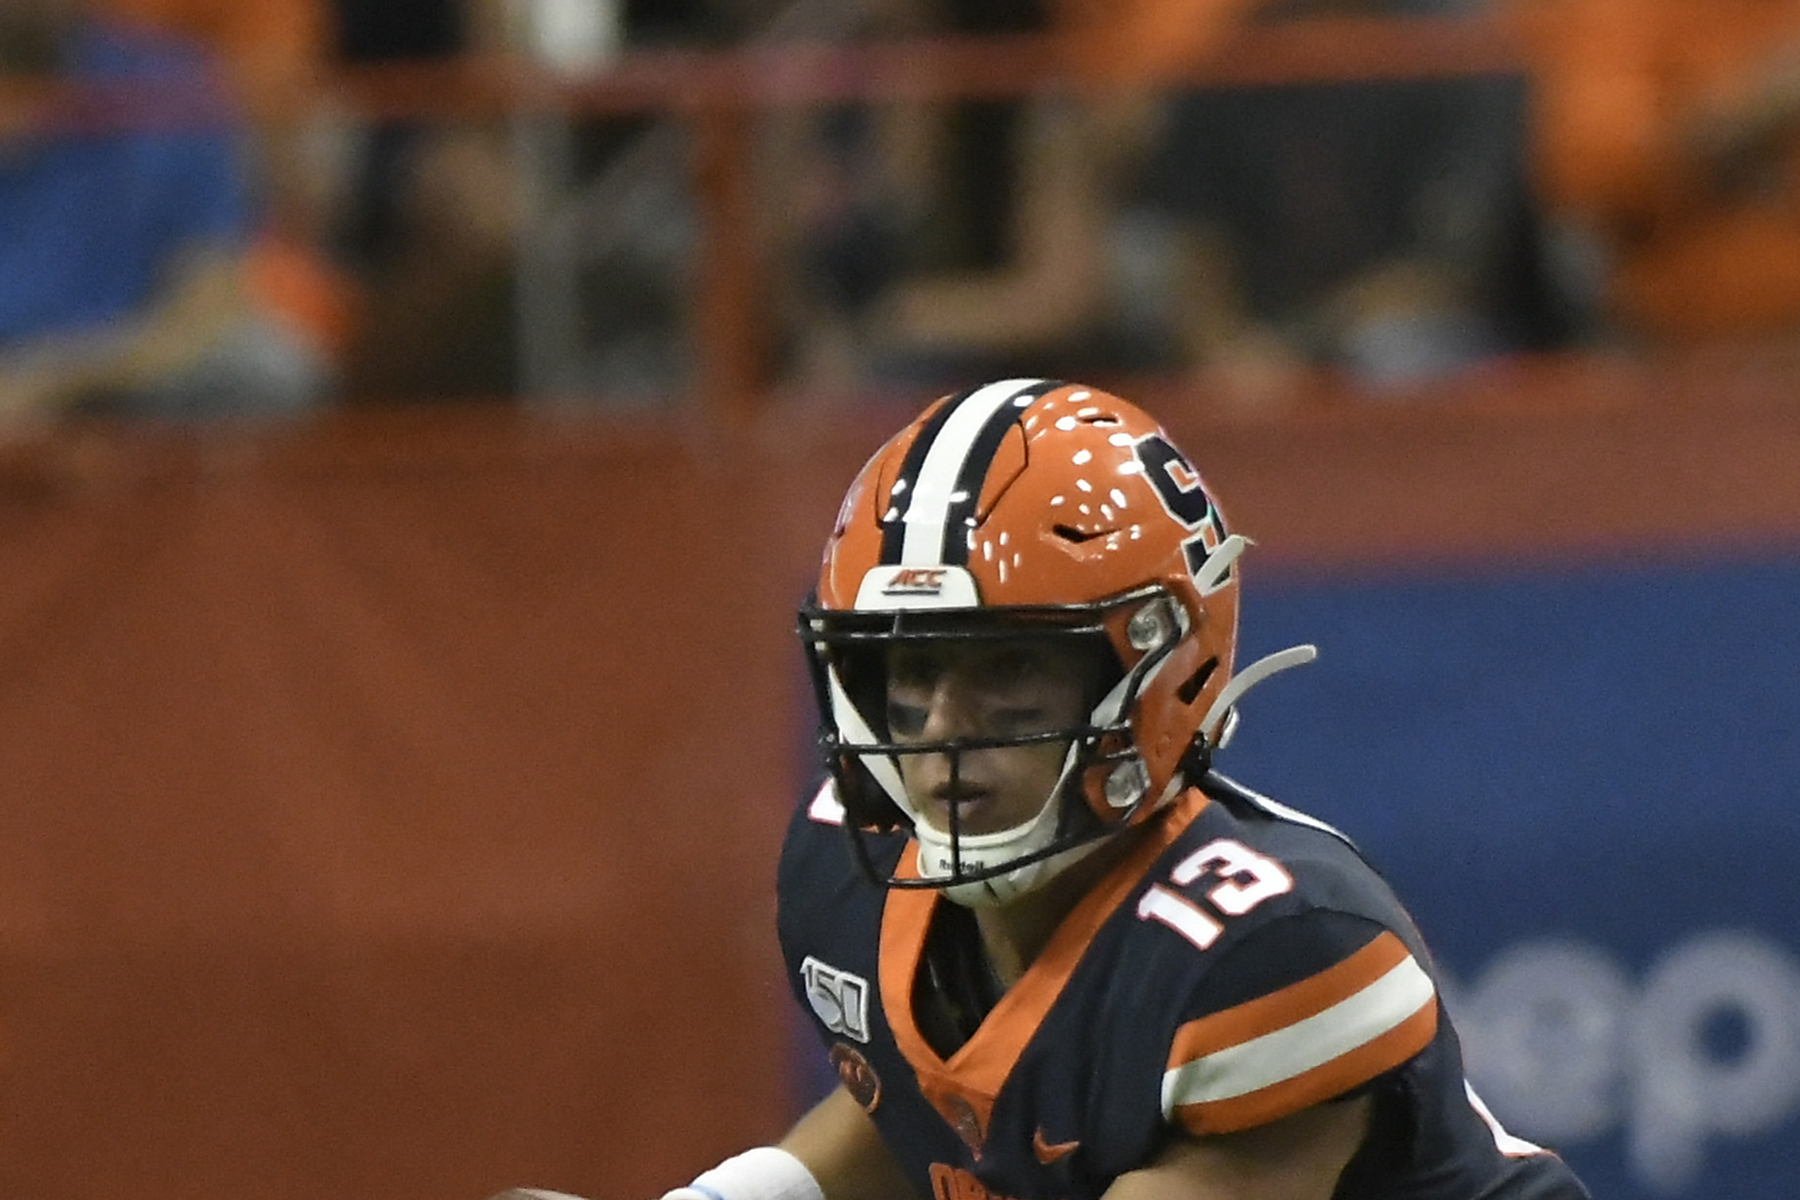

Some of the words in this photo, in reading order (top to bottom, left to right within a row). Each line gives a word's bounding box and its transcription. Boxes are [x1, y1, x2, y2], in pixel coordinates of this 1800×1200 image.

[887, 569, 948, 588] ACC
[1136, 838, 1295, 951] 13
[800, 955, 871, 1043] 150
